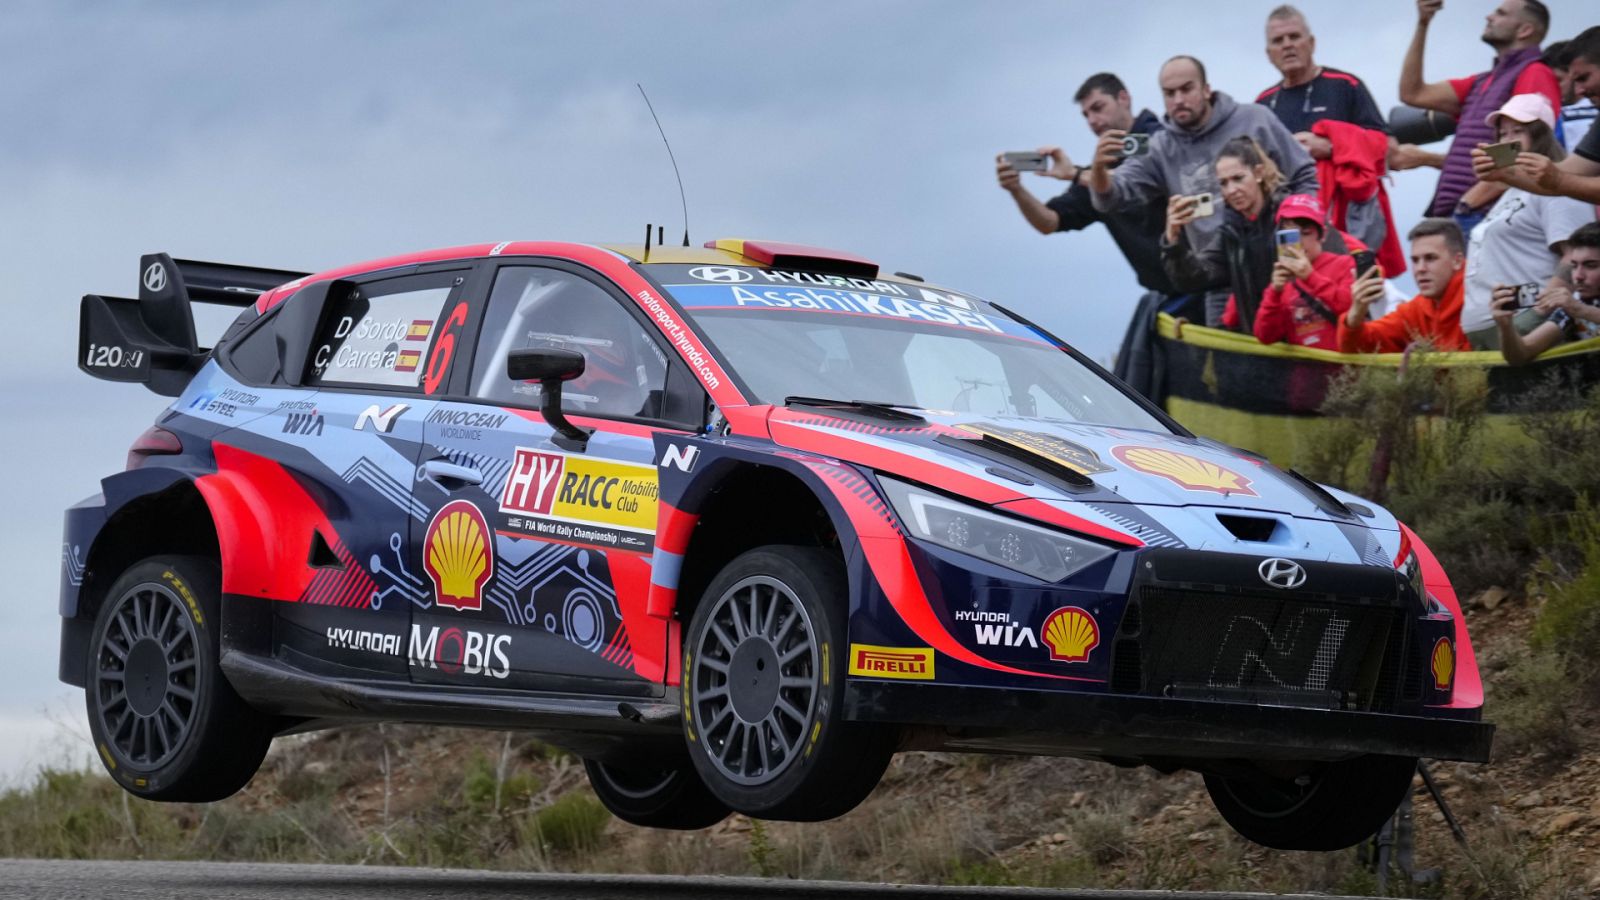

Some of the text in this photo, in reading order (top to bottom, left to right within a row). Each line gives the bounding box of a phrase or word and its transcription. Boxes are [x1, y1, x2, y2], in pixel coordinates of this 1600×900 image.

[334, 316, 408, 341] D. Sordo
[637, 290, 720, 390] motorsport.hyundai.com
[314, 344, 398, 369] C. Carrera
[424, 302, 468, 395] 6
[207, 400, 238, 418] STEEL
[218, 387, 261, 406] HYUNDAI
[279, 400, 317, 411] HYUNDAI
[282, 409, 326, 437] WIA
[428, 408, 510, 429] INNOCEAN
[440, 427, 483, 442] WORLDWIDE
[505, 453, 560, 511] HY
[558, 472, 620, 510] RACC
[620, 479, 659, 503] Mobility
[616, 496, 639, 513] Club
[524, 519, 537, 531] FIA
[537, 521, 556, 534] World
[556, 524, 574, 538] Rally
[573, 528, 618, 545] Championship
[170, 578, 204, 625] ZERO
[955, 610, 1010, 624] HYUNDAI
[975, 621, 1039, 649] WIA
[327, 623, 513, 679] HYUNDAI MOBIS
[857, 650, 927, 674] PIRELLI
